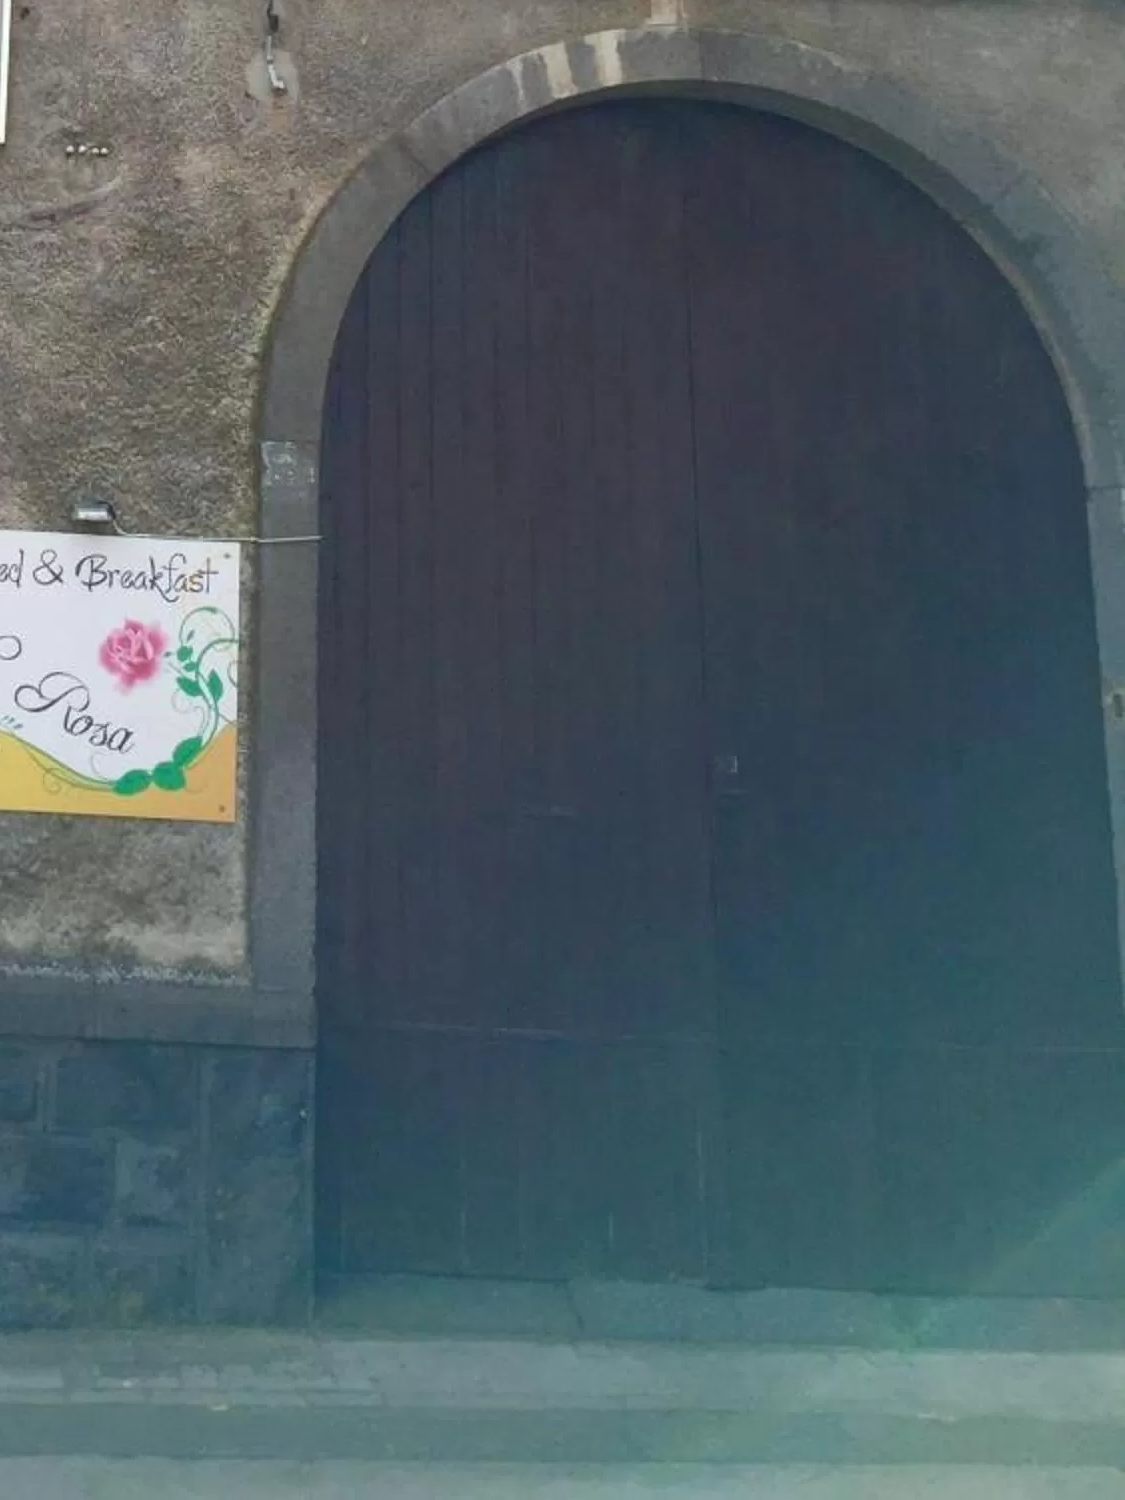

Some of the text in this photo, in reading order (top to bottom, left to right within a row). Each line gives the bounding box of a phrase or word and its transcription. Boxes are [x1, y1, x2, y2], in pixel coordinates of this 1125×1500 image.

[32, 548, 64, 586] &
[75, 553, 219, 603] Breakfast
[13, 671, 136, 755] Rosa
